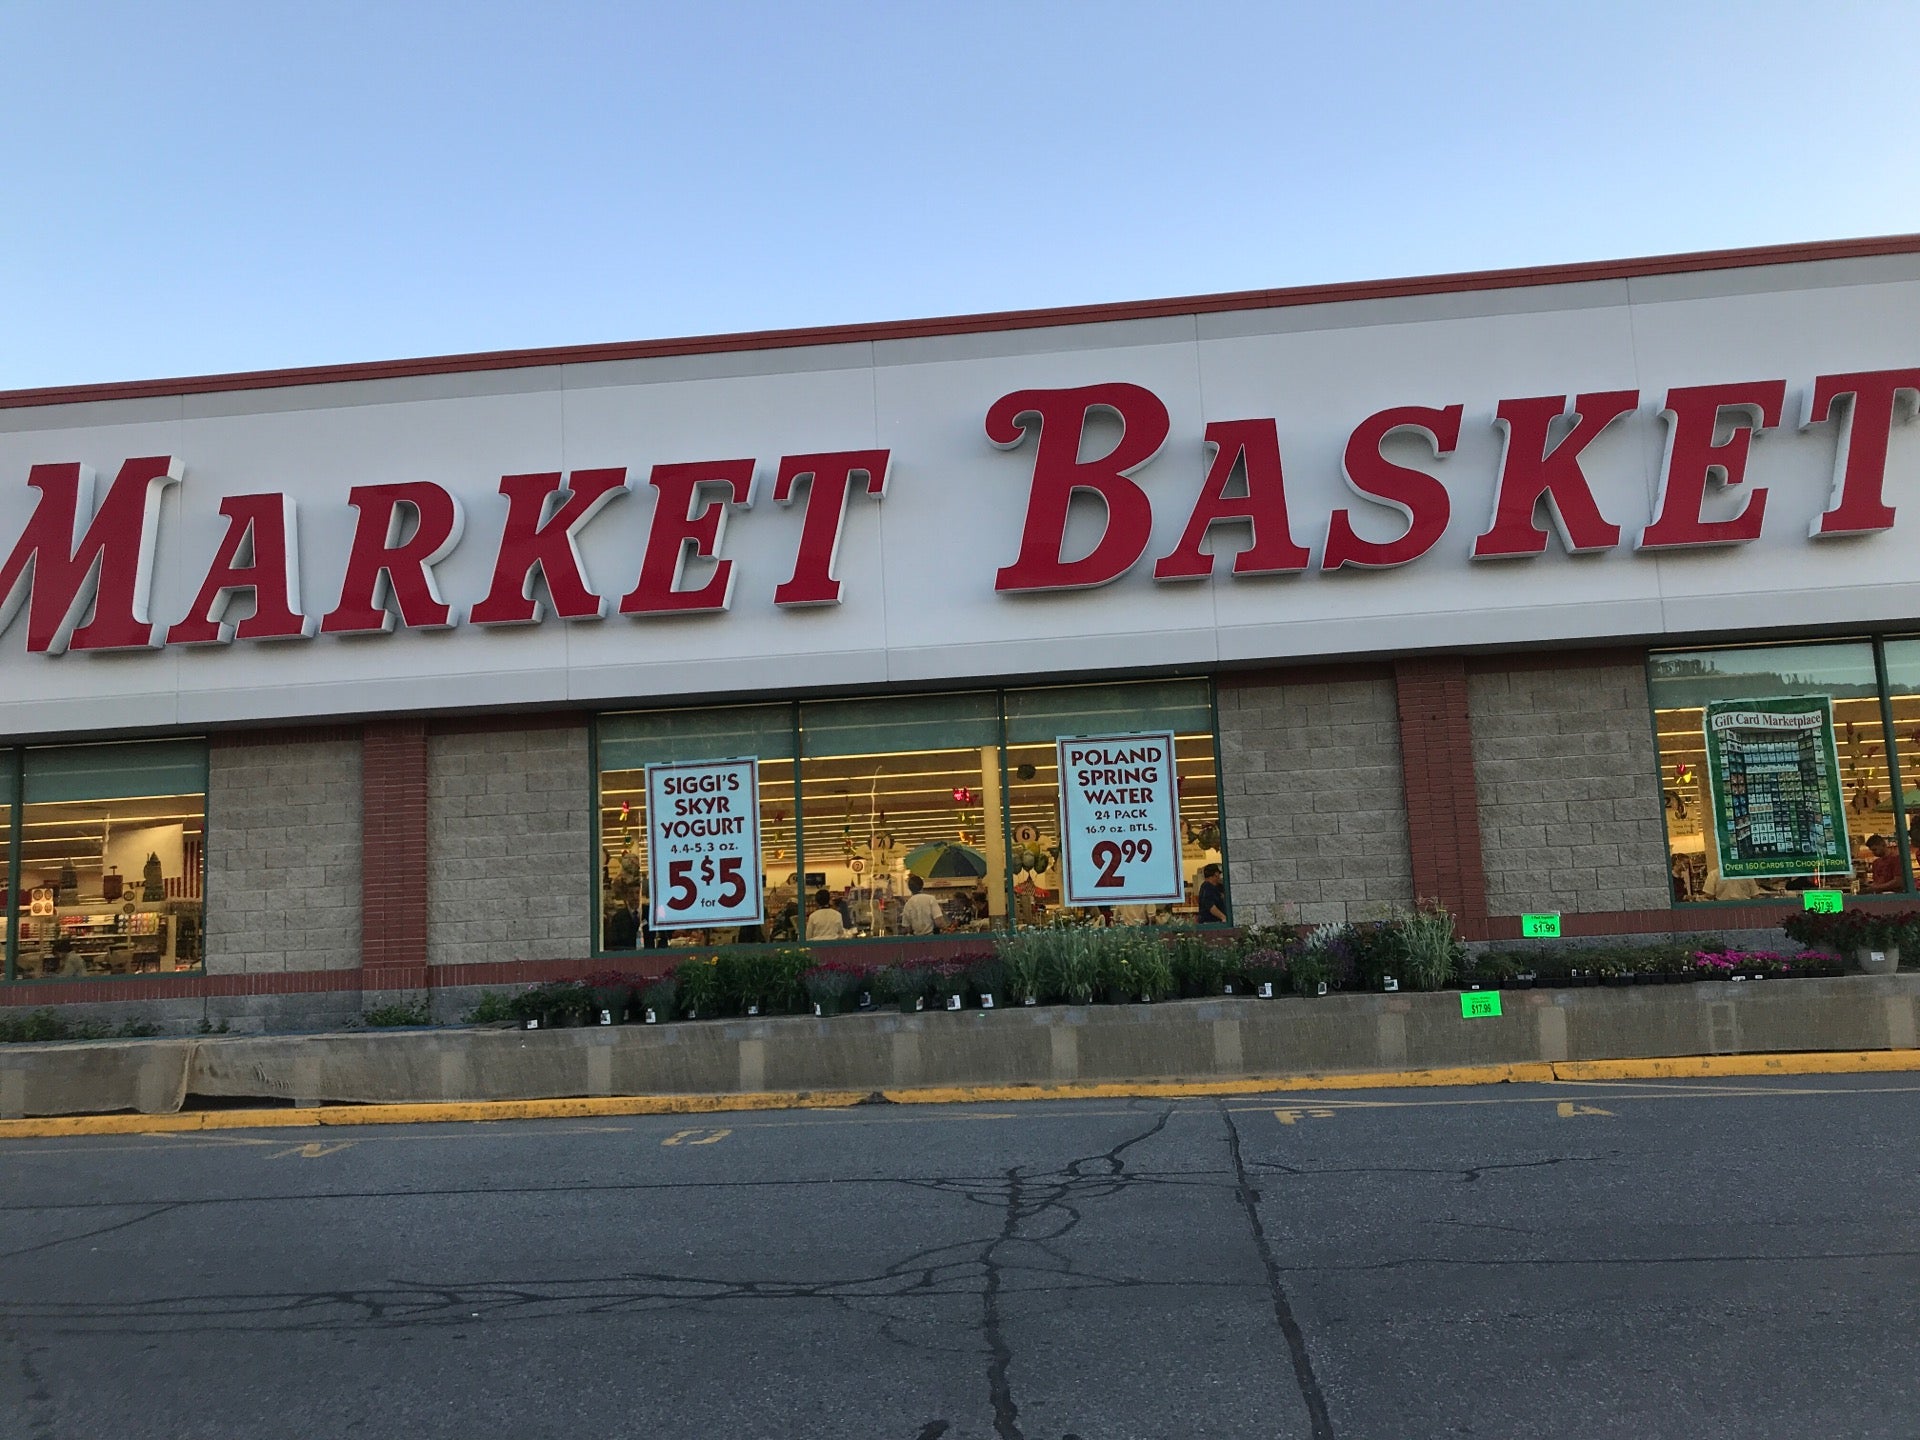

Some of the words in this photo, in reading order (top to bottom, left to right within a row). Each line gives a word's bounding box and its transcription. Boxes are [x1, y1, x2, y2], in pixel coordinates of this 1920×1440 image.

[0, 448, 892, 656] MARKET
[984, 368, 1920, 595] BASKET
[1715, 714, 1733, 727] Gift
[1736, 713, 1760, 725] Card
[1762, 714, 1821, 728] Marketplace
[1071, 747, 1162, 766] POLAND
[663, 773, 740, 795] SIGGI'S
[1077, 767, 1158, 786] SPRING
[1084, 787, 1154, 805] WATER
[674, 796, 730, 816] SKYR
[1094, 810, 1110, 820] 24
[1115, 809, 1148, 819] PACK
[661, 817, 745, 838] YOGURT
[1021, 828, 1031, 840] 6
[1085, 825, 1106, 834] 16.9
[1109, 825, 1126, 833] oz.
[1129, 823, 1157, 832] BTLS.
[670, 842, 715, 854] 4.4-5.3
[719, 842, 739, 851] oz.
[666, 859, 698, 911] 5
[700, 896, 716, 907] for
[1533, 923, 1556, 933] $1.99
